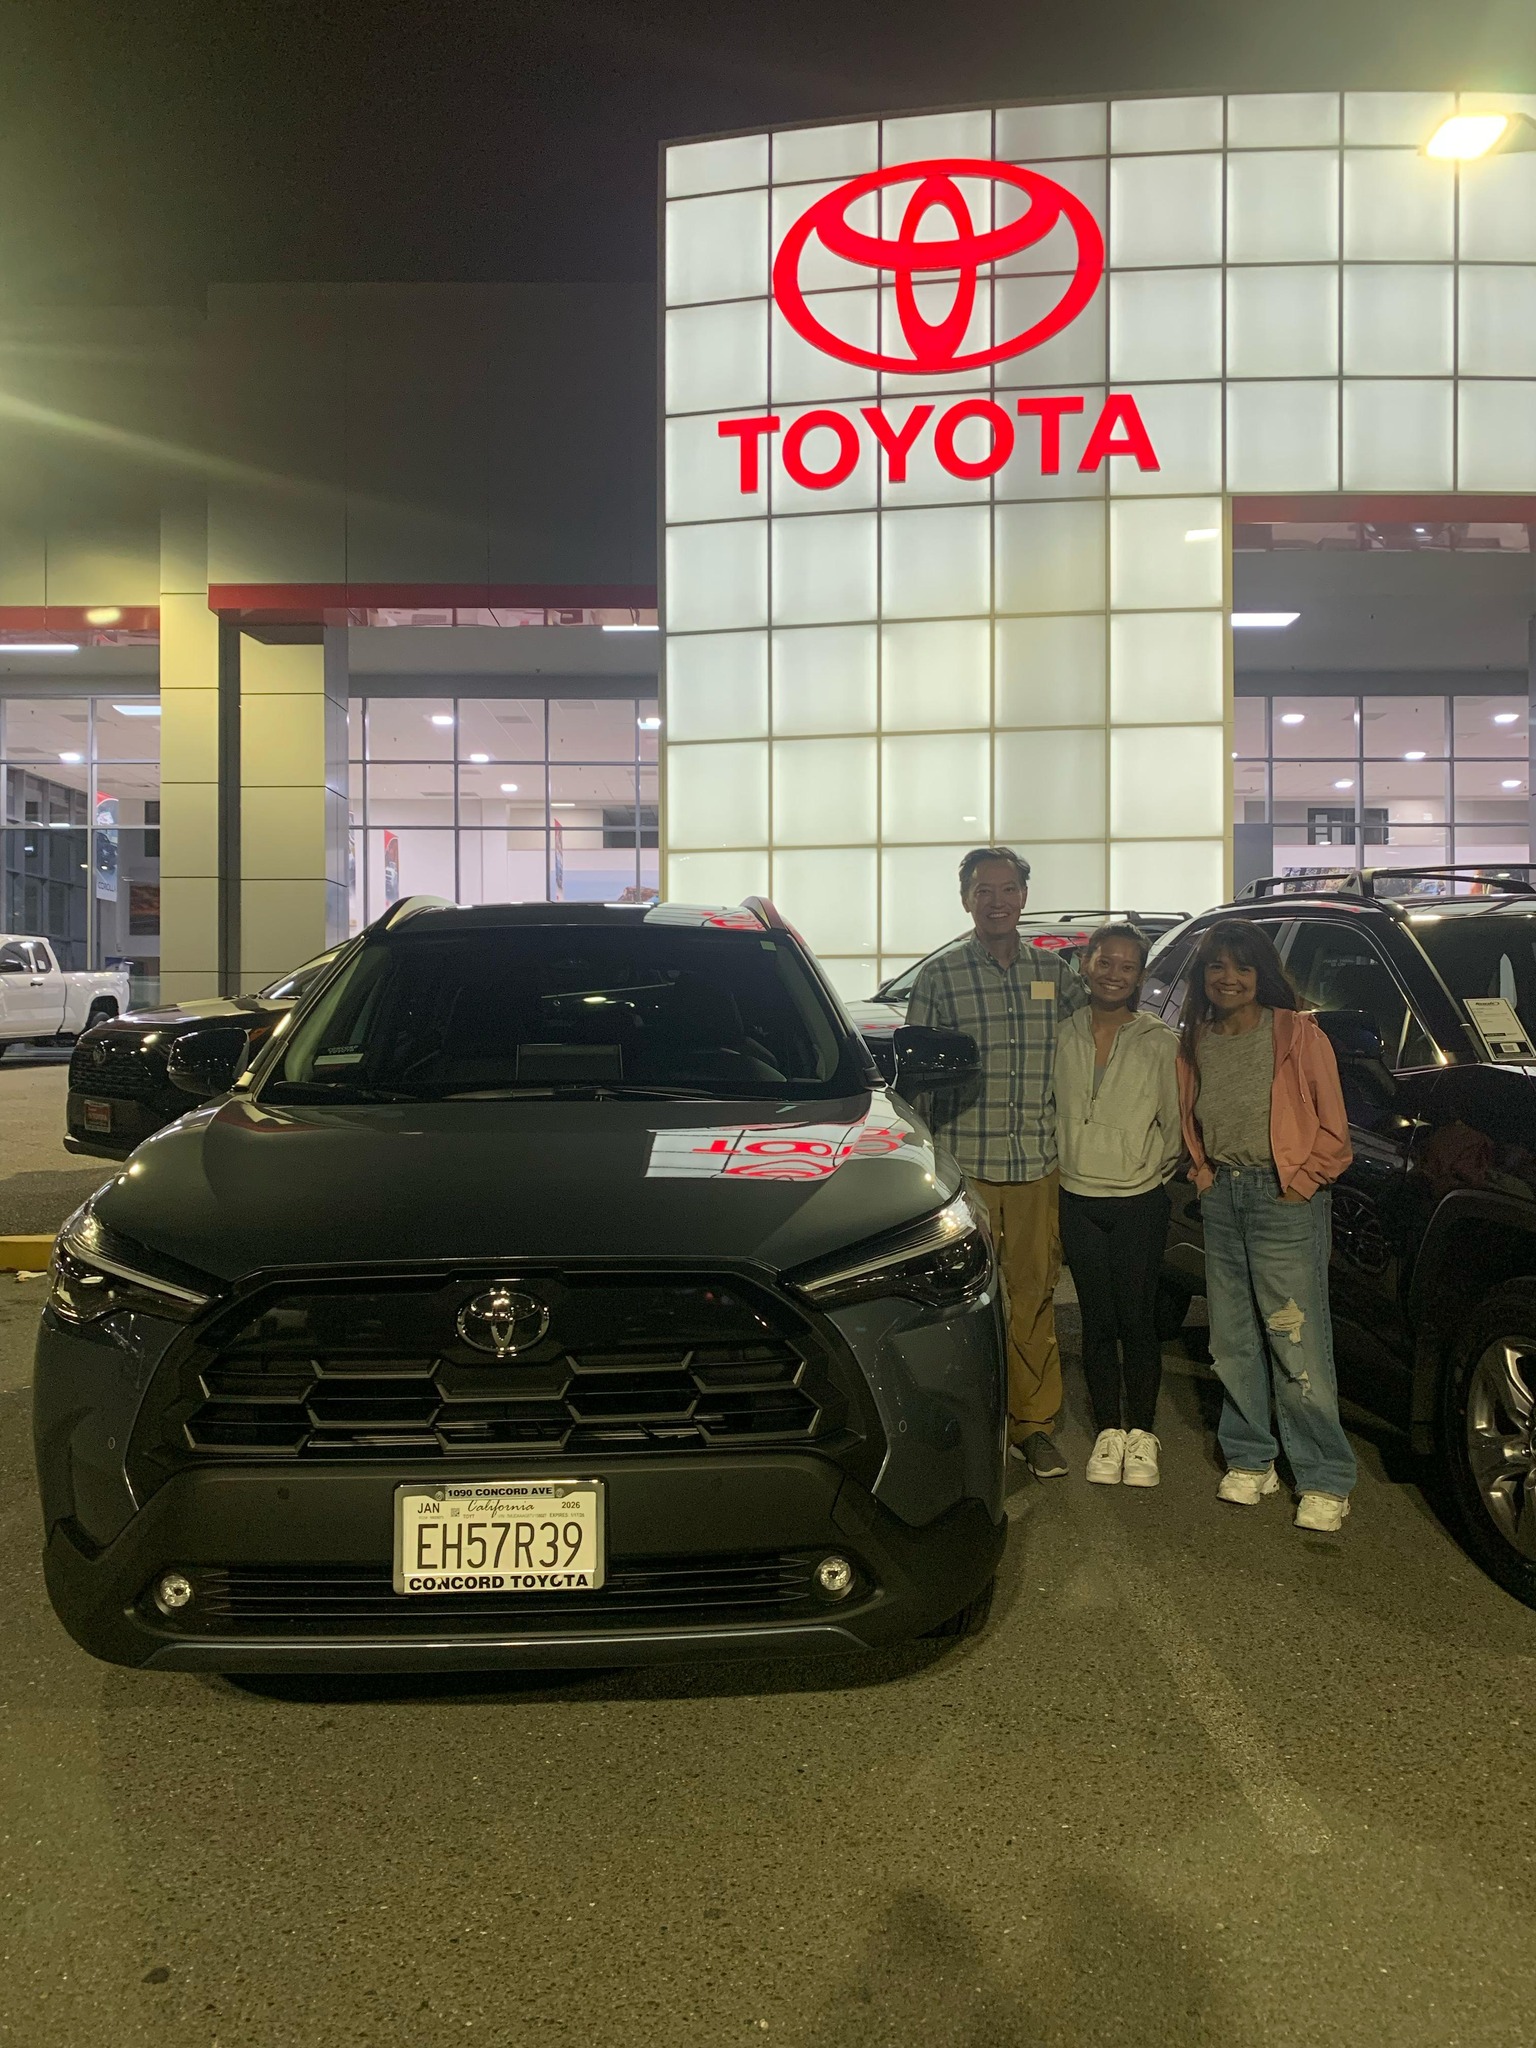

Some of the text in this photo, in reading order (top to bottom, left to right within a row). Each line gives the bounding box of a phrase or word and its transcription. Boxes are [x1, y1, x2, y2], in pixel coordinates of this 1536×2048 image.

[718, 394, 1160, 494] TOYOTA
[448, 1487, 553, 1497] 1090 CONCORD AVE
[417, 1503, 440, 1514] JAN
[467, 1500, 535, 1518] California
[561, 1501, 581, 1509] 2026
[417, 1521, 583, 1569] EH57R39
[409, 1574, 588, 1591] CONCORD TOYOTA
